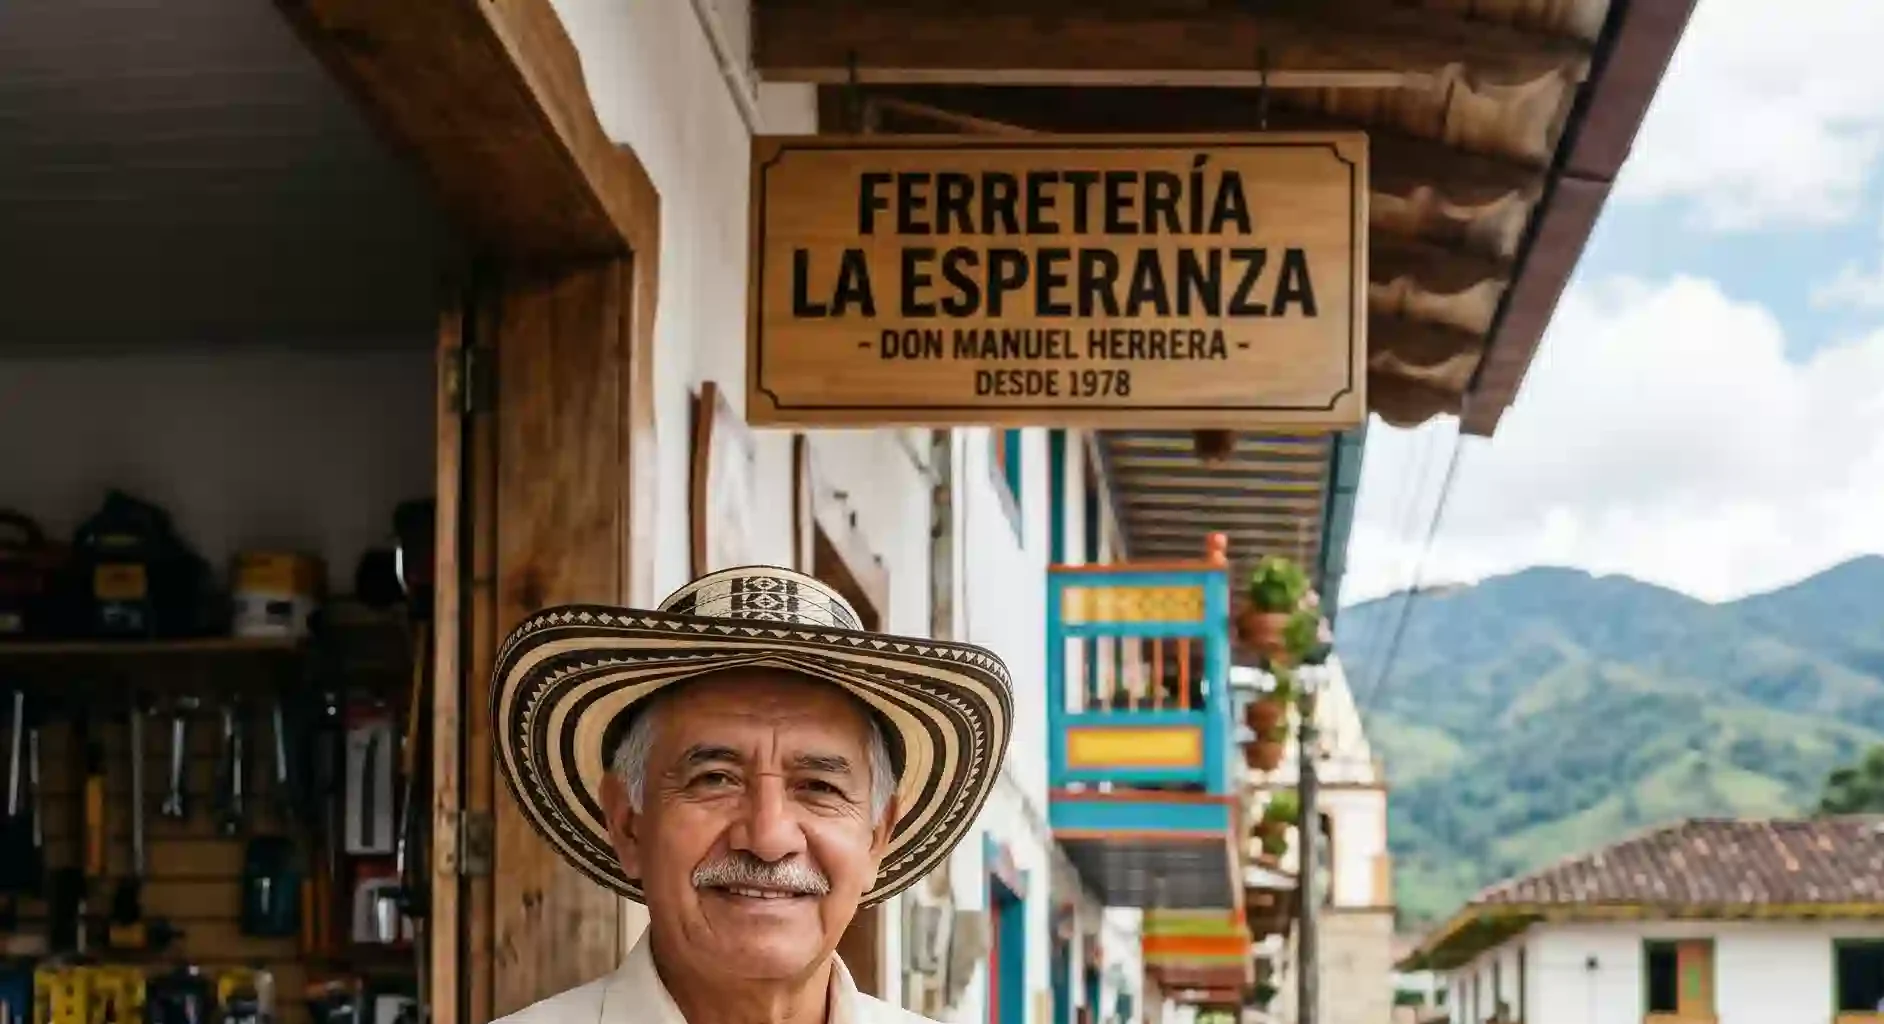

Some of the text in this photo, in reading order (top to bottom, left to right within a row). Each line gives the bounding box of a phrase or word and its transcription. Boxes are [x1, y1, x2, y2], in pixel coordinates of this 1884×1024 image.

[858, 153, 1252, 235] FERRETERÍA
[792, 247, 1318, 318] LA ESPERANZA
[880, 328, 944, 361] DON
[952, 328, 1079, 361] MANUEL
[1087, 328, 1228, 361] HERRERA
[974, 369, 1131, 398] DESDE 1978
